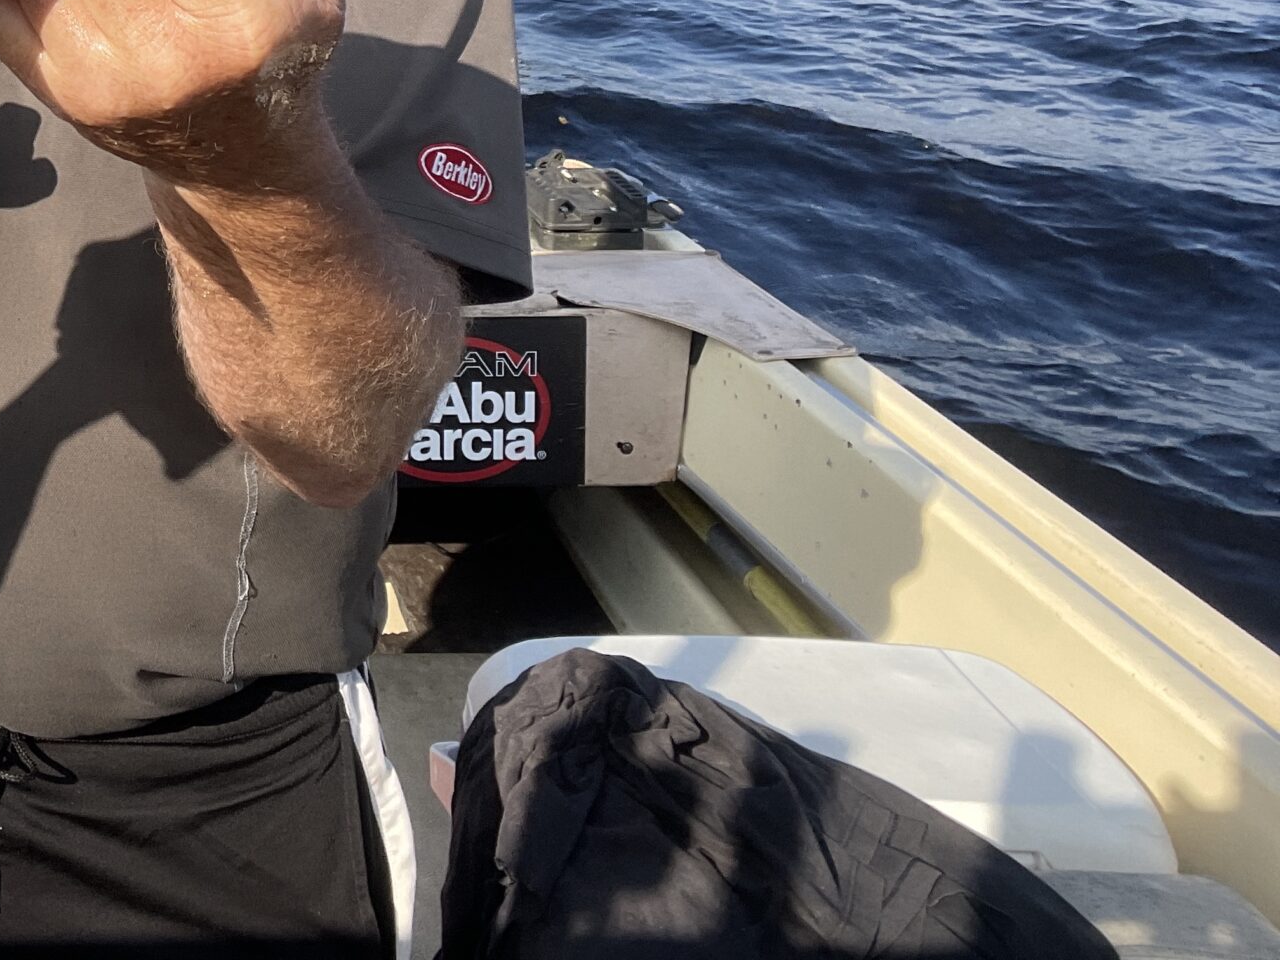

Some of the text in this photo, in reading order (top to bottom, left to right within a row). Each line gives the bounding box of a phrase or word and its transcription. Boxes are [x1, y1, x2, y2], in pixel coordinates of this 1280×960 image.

[431, 151, 486, 198] Berkley
[454, 351, 538, 377] AM
[429, 381, 536, 424] Abu
[404, 428, 537, 461] arcia
